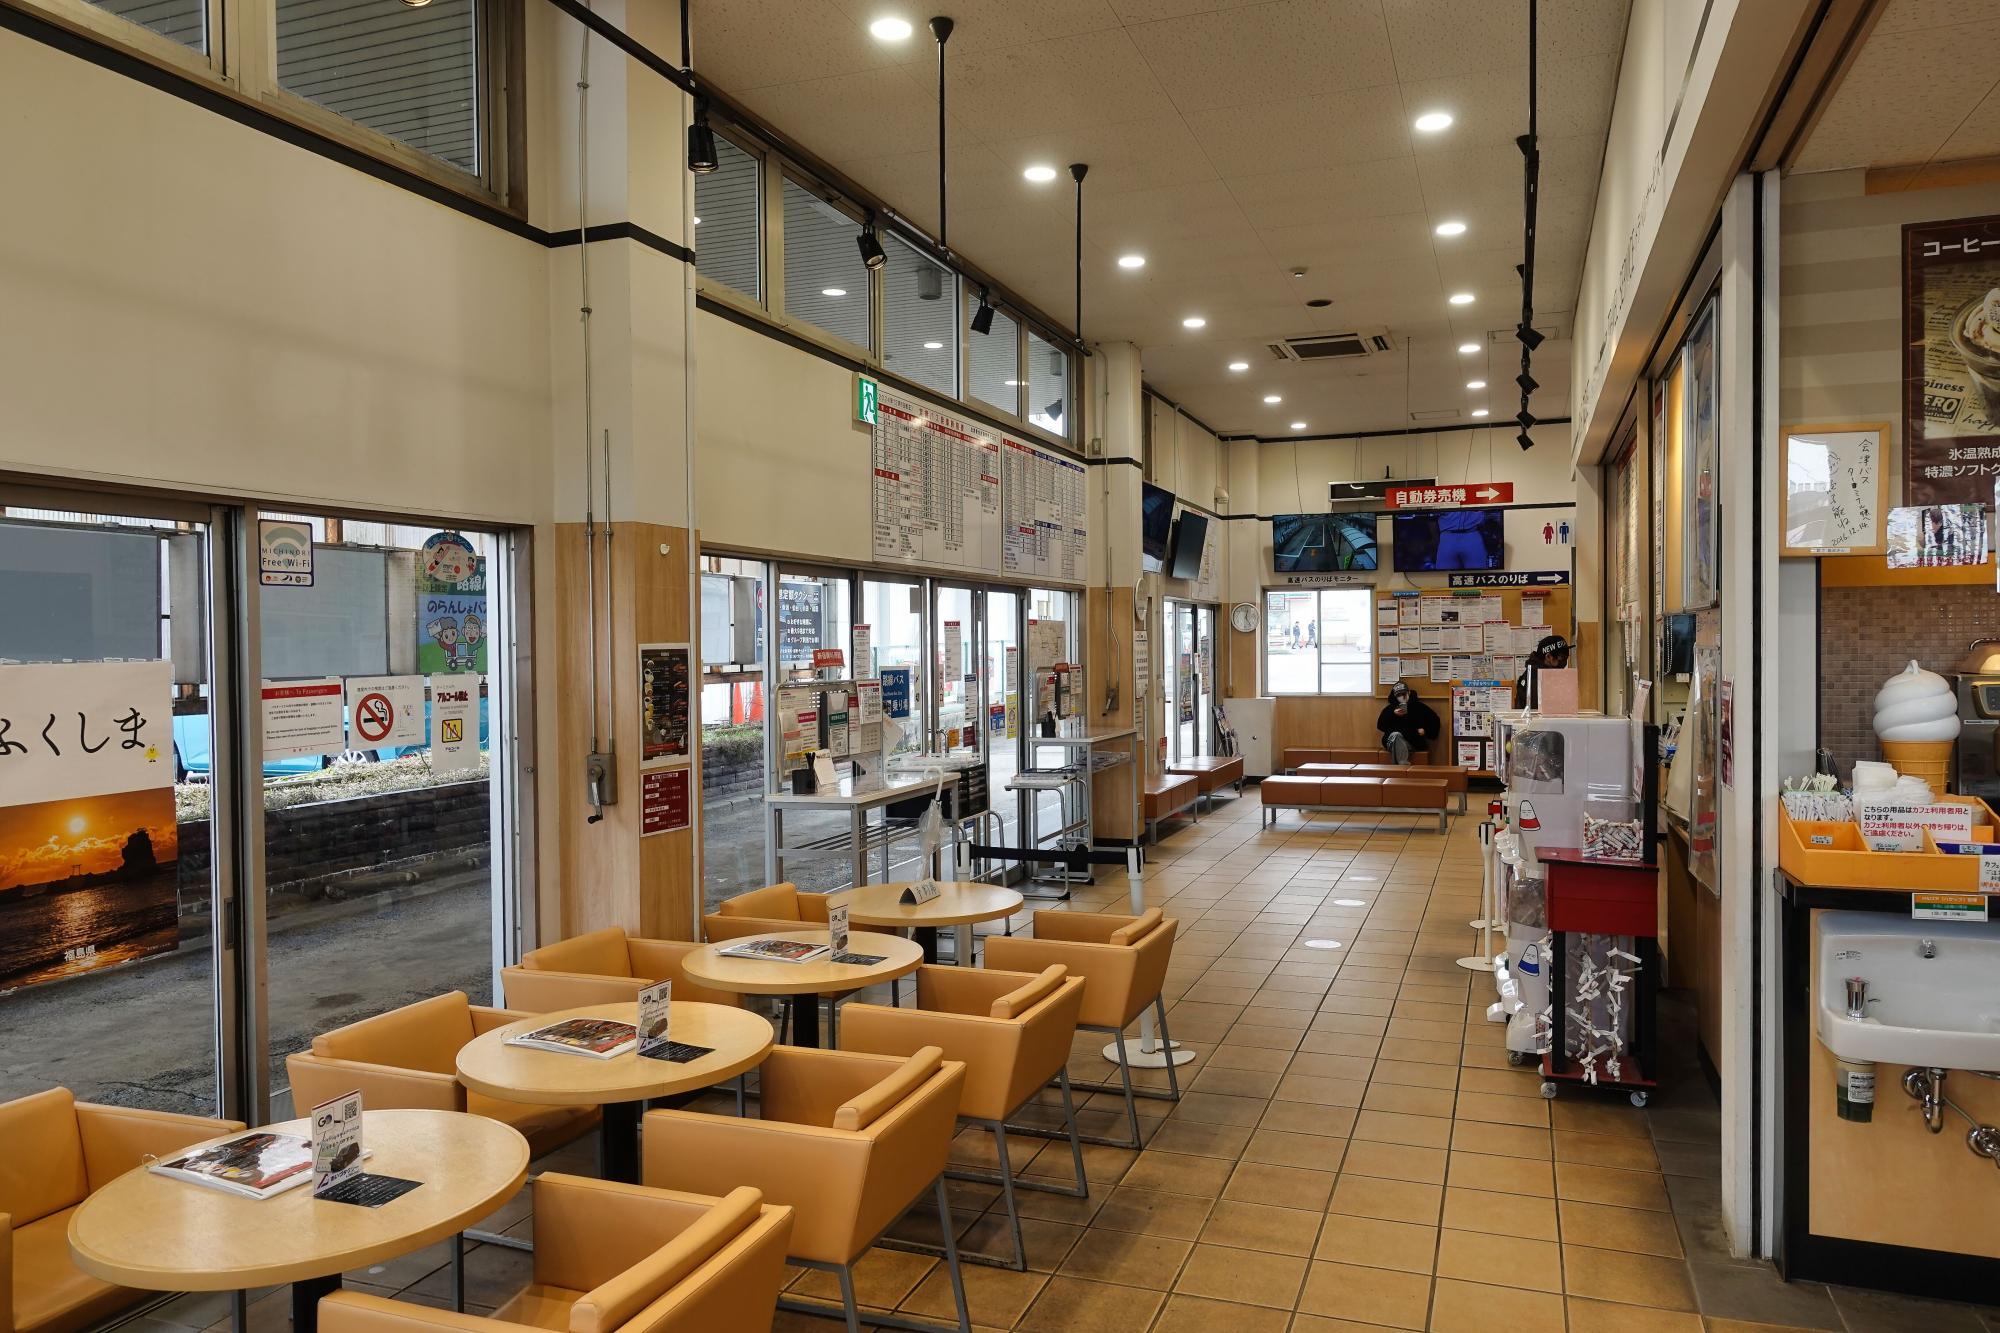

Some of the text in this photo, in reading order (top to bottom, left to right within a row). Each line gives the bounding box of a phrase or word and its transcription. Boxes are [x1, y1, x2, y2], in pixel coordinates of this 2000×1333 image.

[1396, 488, 1467, 505] 自動券売機
[262, 548, 310, 556] MICHINORI
[262, 557, 310, 568] Free Wi-Fi
[1287, 575, 1360, 585] 高速バスのりばモニター
[1451, 573, 1529, 586] 高速バスのりば
[1542, 643, 1556, 654] NEW
[437, 690, 469, 703] アルコール禁止
[1863, 806, 1969, 815] こちらの用品はカフェ利用者用と
[1863, 830, 1915, 838] ご遠慮ください。
[63, 944, 97, 963] 福島県
[317, 1114, 333, 1128] GO
